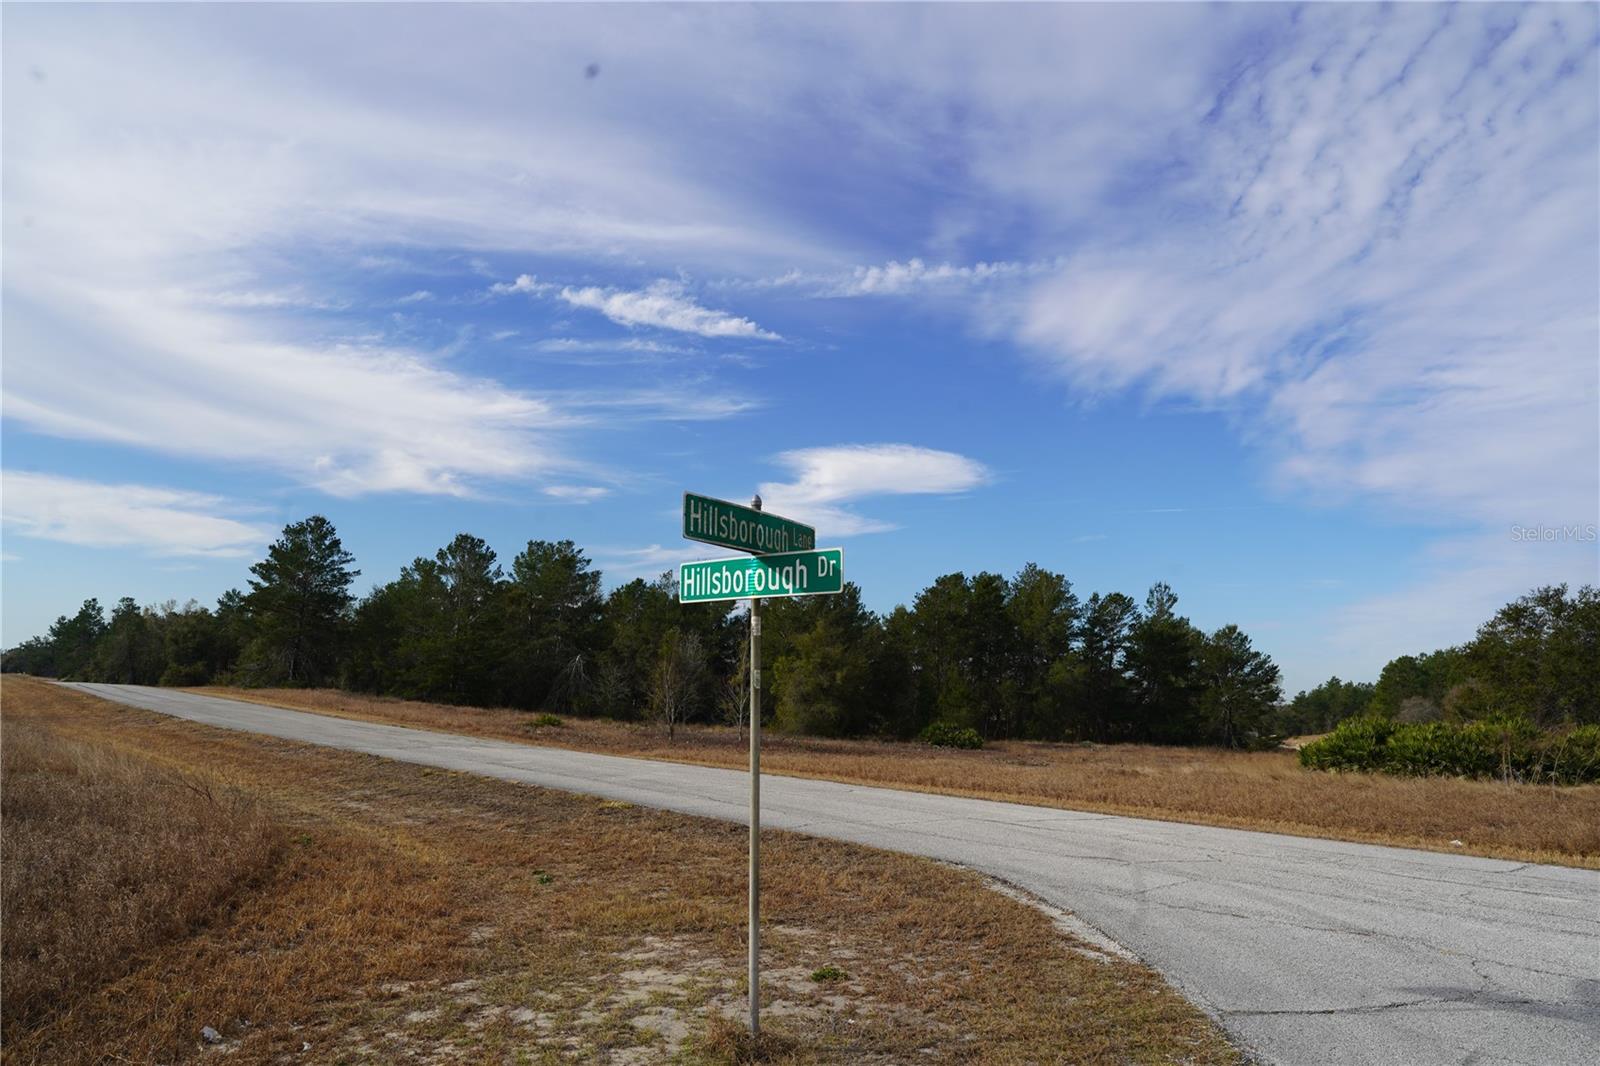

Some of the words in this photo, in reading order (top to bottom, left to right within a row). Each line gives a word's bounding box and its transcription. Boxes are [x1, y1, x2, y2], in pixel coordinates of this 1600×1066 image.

[690, 500, 789, 552] Hillsborough
[793, 527, 812, 550] Lane
[684, 558, 808, 595] Hillsborough
[818, 556, 837, 577] Dr
